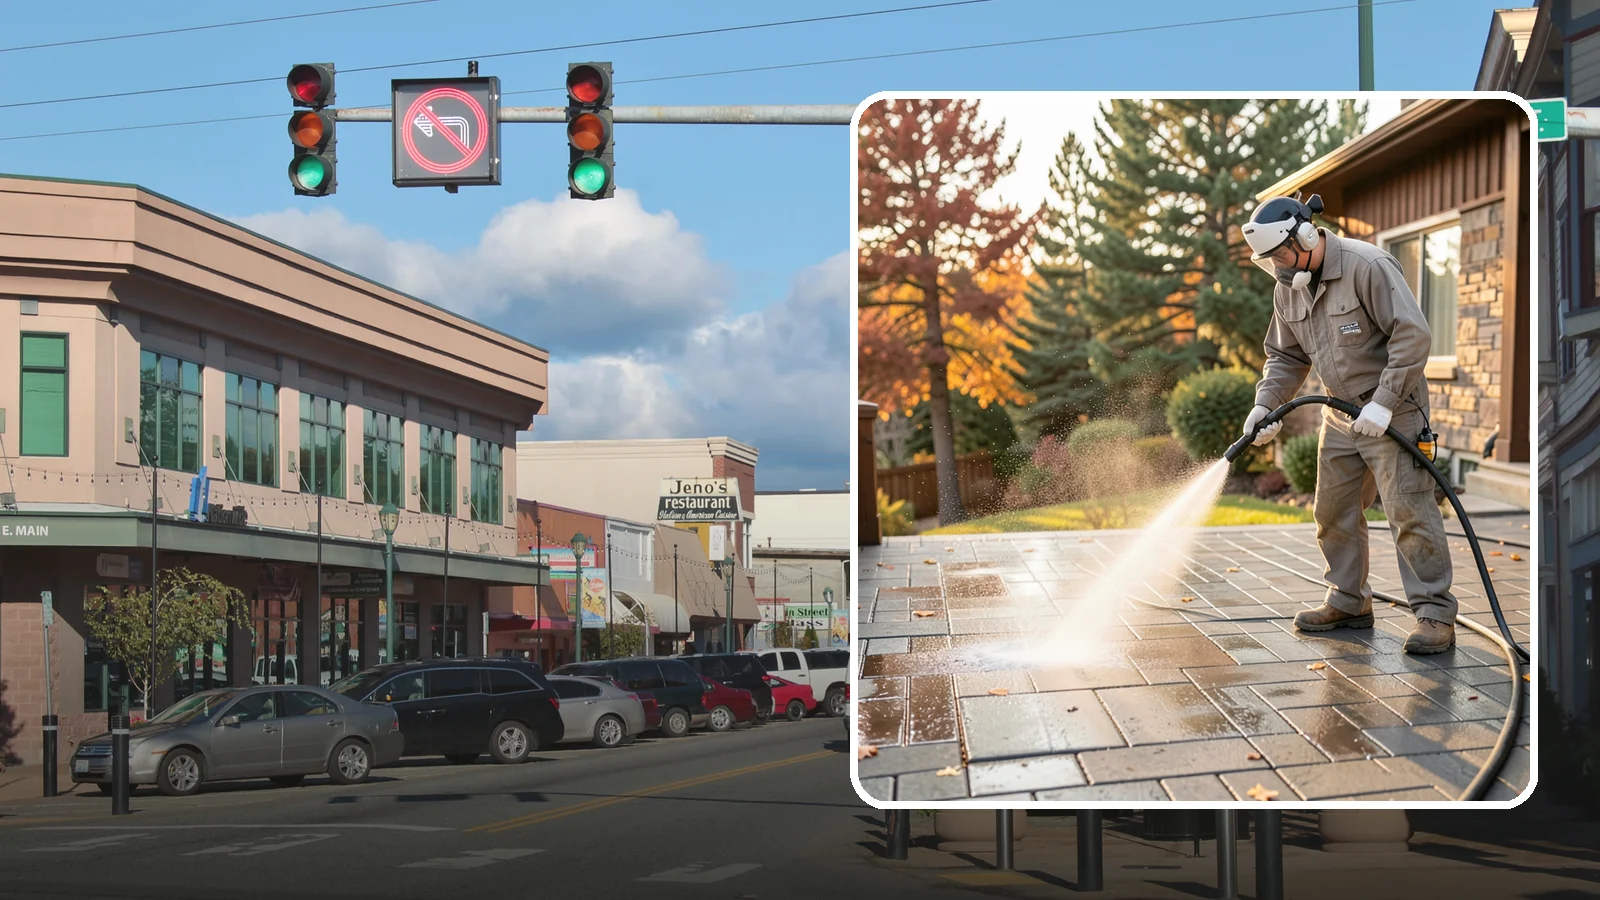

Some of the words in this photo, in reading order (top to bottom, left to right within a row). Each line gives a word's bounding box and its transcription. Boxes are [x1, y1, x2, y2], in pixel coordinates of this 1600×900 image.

[670, 480, 727, 494] Jeno's
[665, 496, 731, 509] restaurant
[659, 510, 681, 519] Italian
[686, 510, 714, 519] American
[715, 510, 738, 519] Cuisine
[2, 525, 13, 536] E.
[15, 525, 49, 536] MAIN
[797, 607, 828, 616] Street
[791, 619, 823, 627] lass
